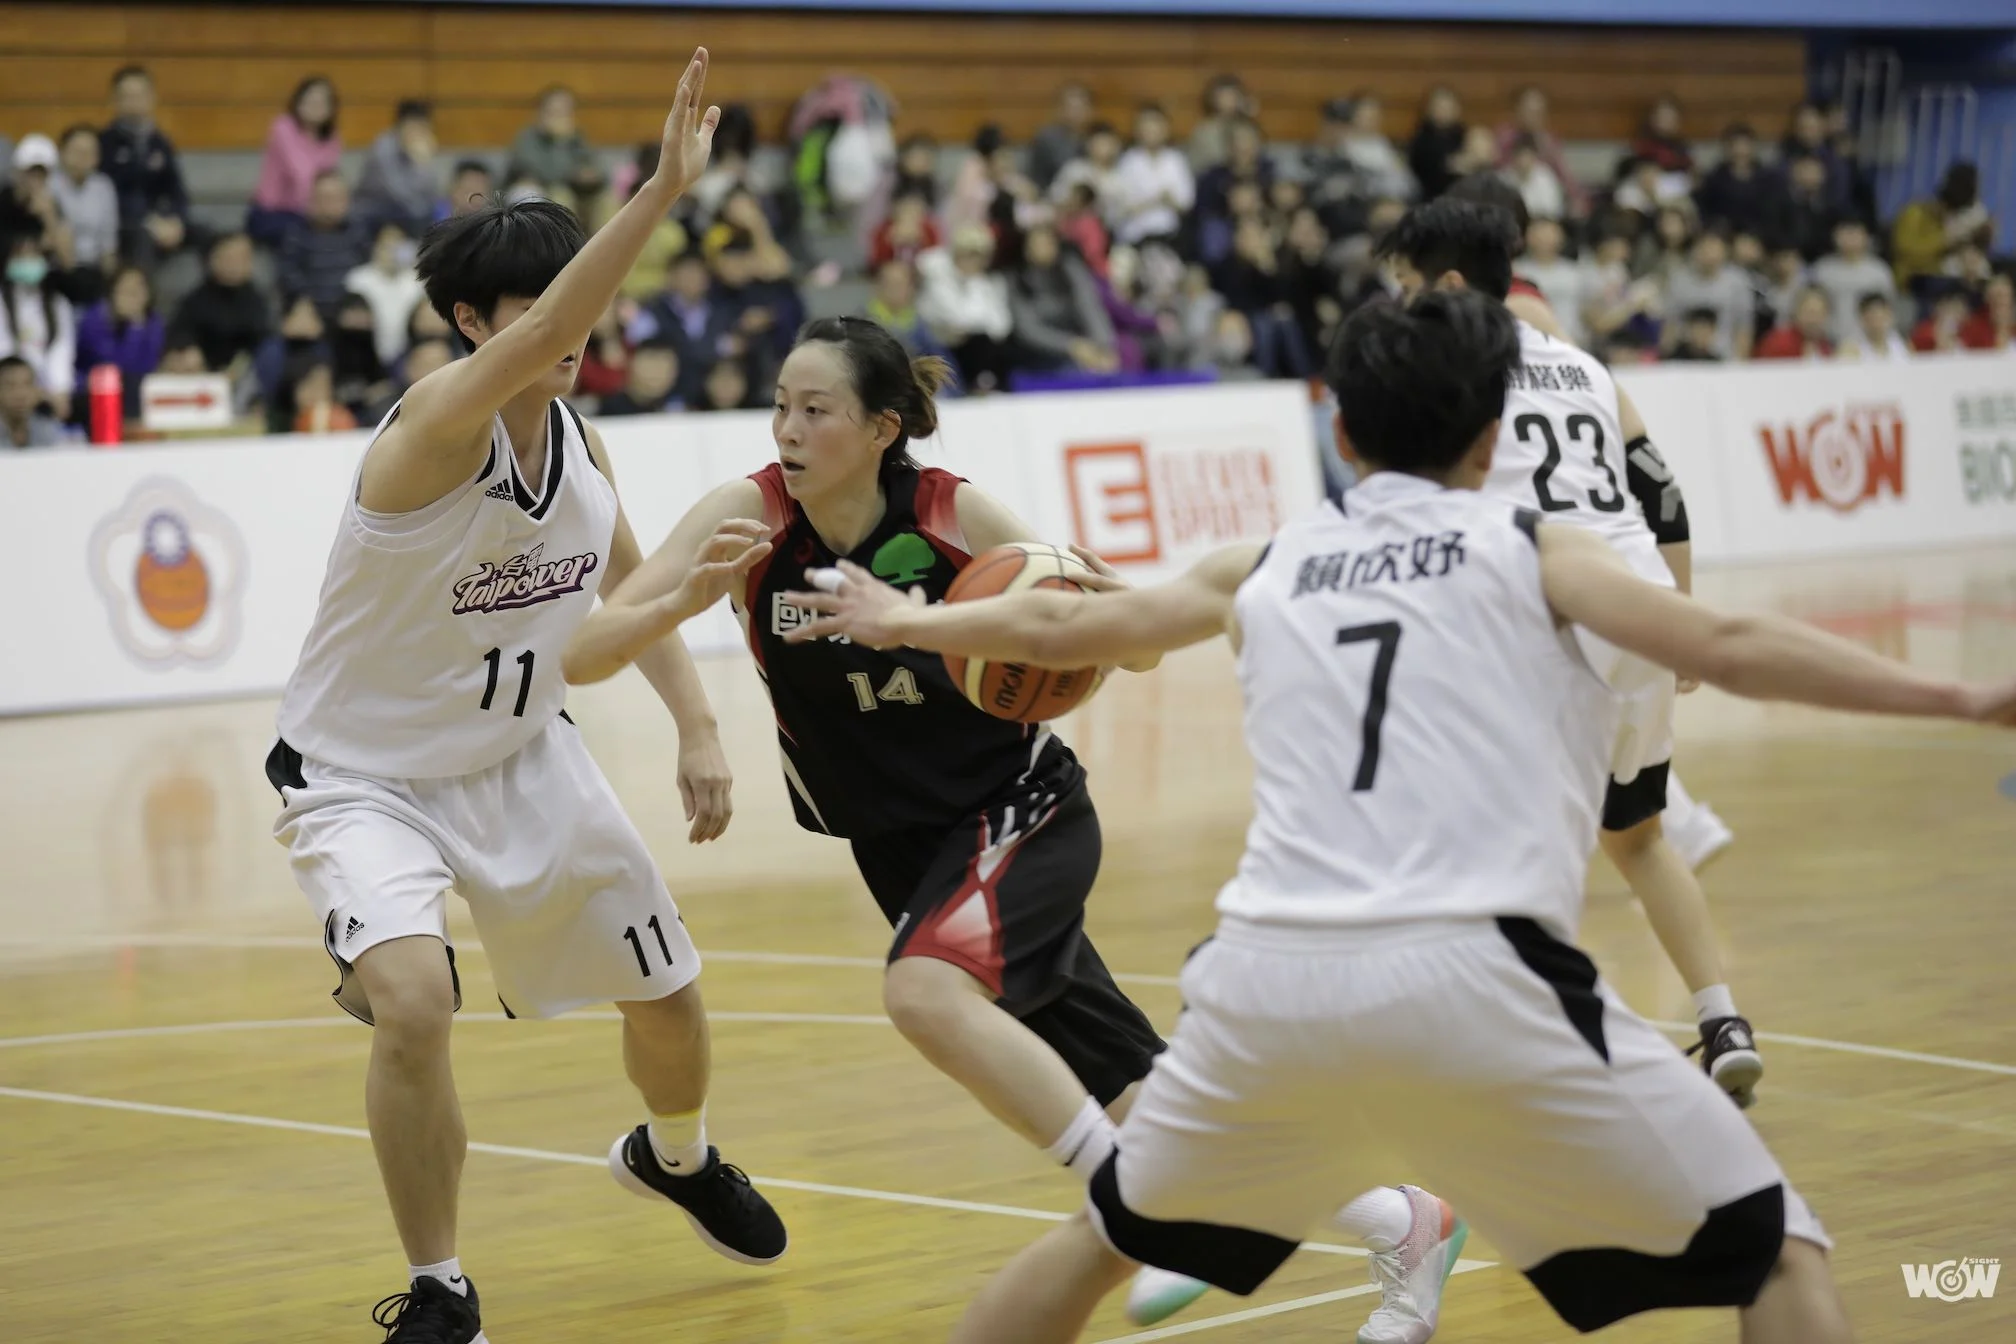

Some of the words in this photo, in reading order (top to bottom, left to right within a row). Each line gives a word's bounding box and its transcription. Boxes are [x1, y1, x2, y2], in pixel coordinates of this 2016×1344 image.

[1514, 414, 1625, 512] 23
[1758, 409, 1906, 512] WOW
[485, 490, 514, 502] adidas
[452, 552, 598, 615] Taipower
[479, 646, 535, 718] 11
[846, 666, 925, 712] 14
[1335, 620, 1403, 792] 7
[623, 914, 673, 978] 11
